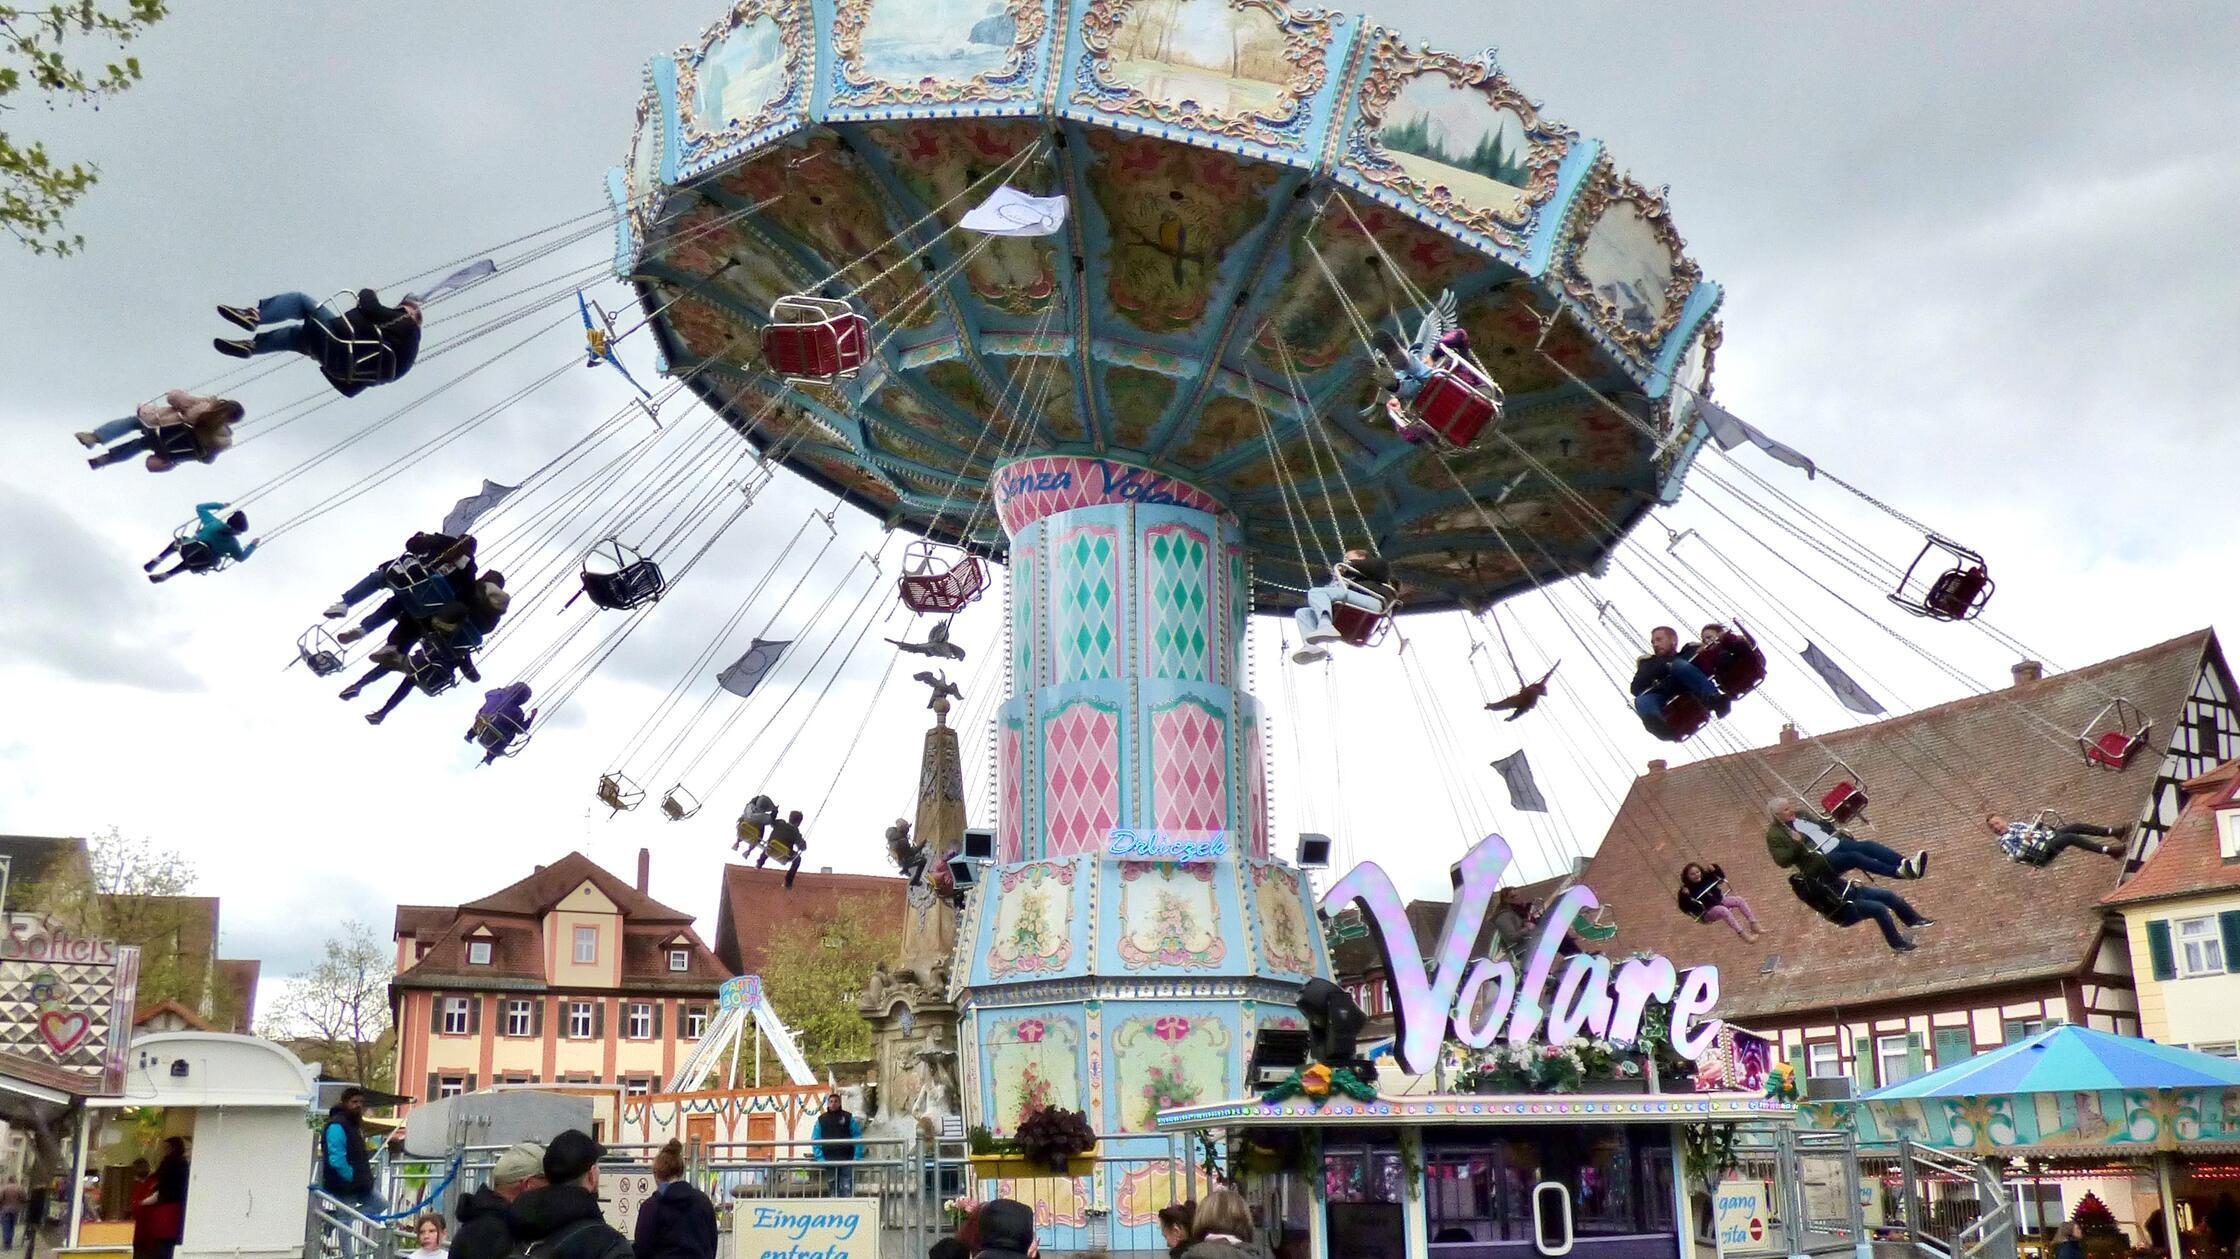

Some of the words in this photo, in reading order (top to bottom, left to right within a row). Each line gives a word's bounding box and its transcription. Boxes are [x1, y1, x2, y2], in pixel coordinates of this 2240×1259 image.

[6, 923, 113, 962] Softeis
[1318, 833, 1723, 1075] Volare
[752, 1207, 860, 1240] Eingang
[1718, 1196, 1756, 1221] gang
